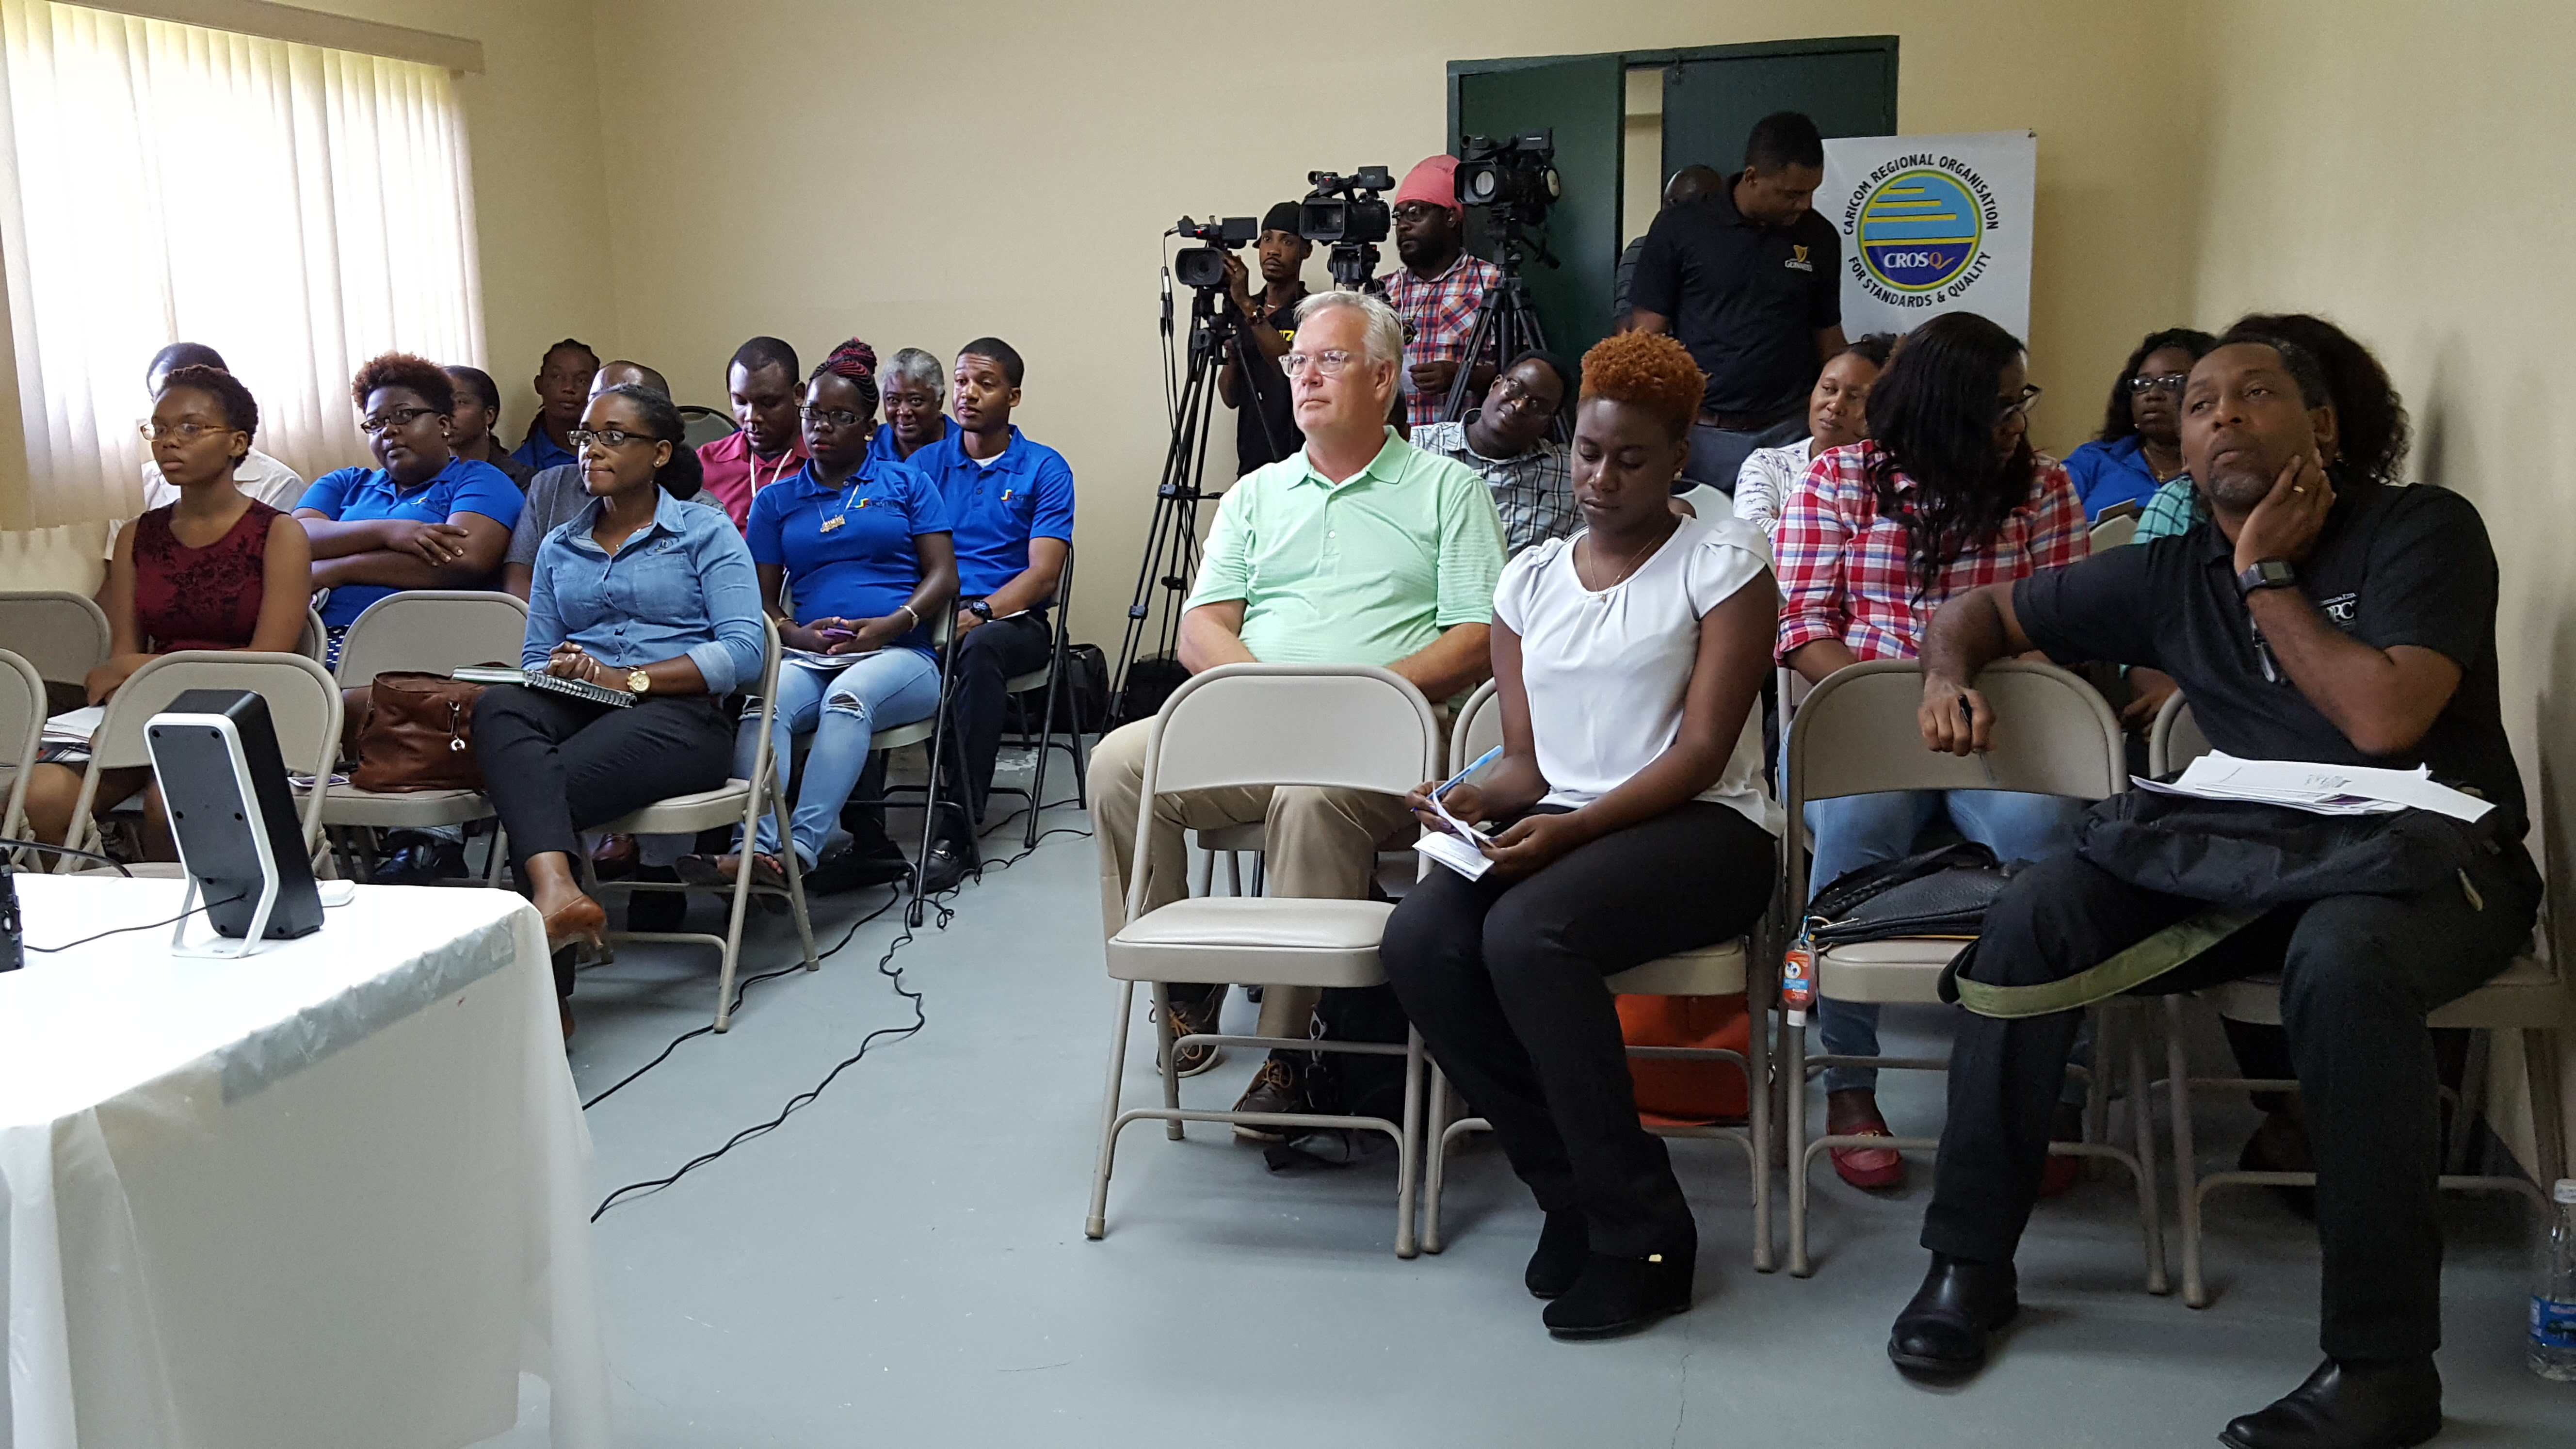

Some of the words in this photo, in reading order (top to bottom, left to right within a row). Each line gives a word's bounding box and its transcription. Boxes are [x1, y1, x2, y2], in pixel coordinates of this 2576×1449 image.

[1843, 180, 1871, 235] CARICOM
[1870, 153, 1934, 183] REGIONAL
[1939, 156, 1998, 230] ORGANISATION
[1848, 256, 1866, 281] FOR
[1863, 278, 1932, 308] STANDARDS
[1937, 291, 1946, 304] &
[1948, 251, 1991, 297] QUALITY
[1884, 252, 1955, 270] CROSQ
